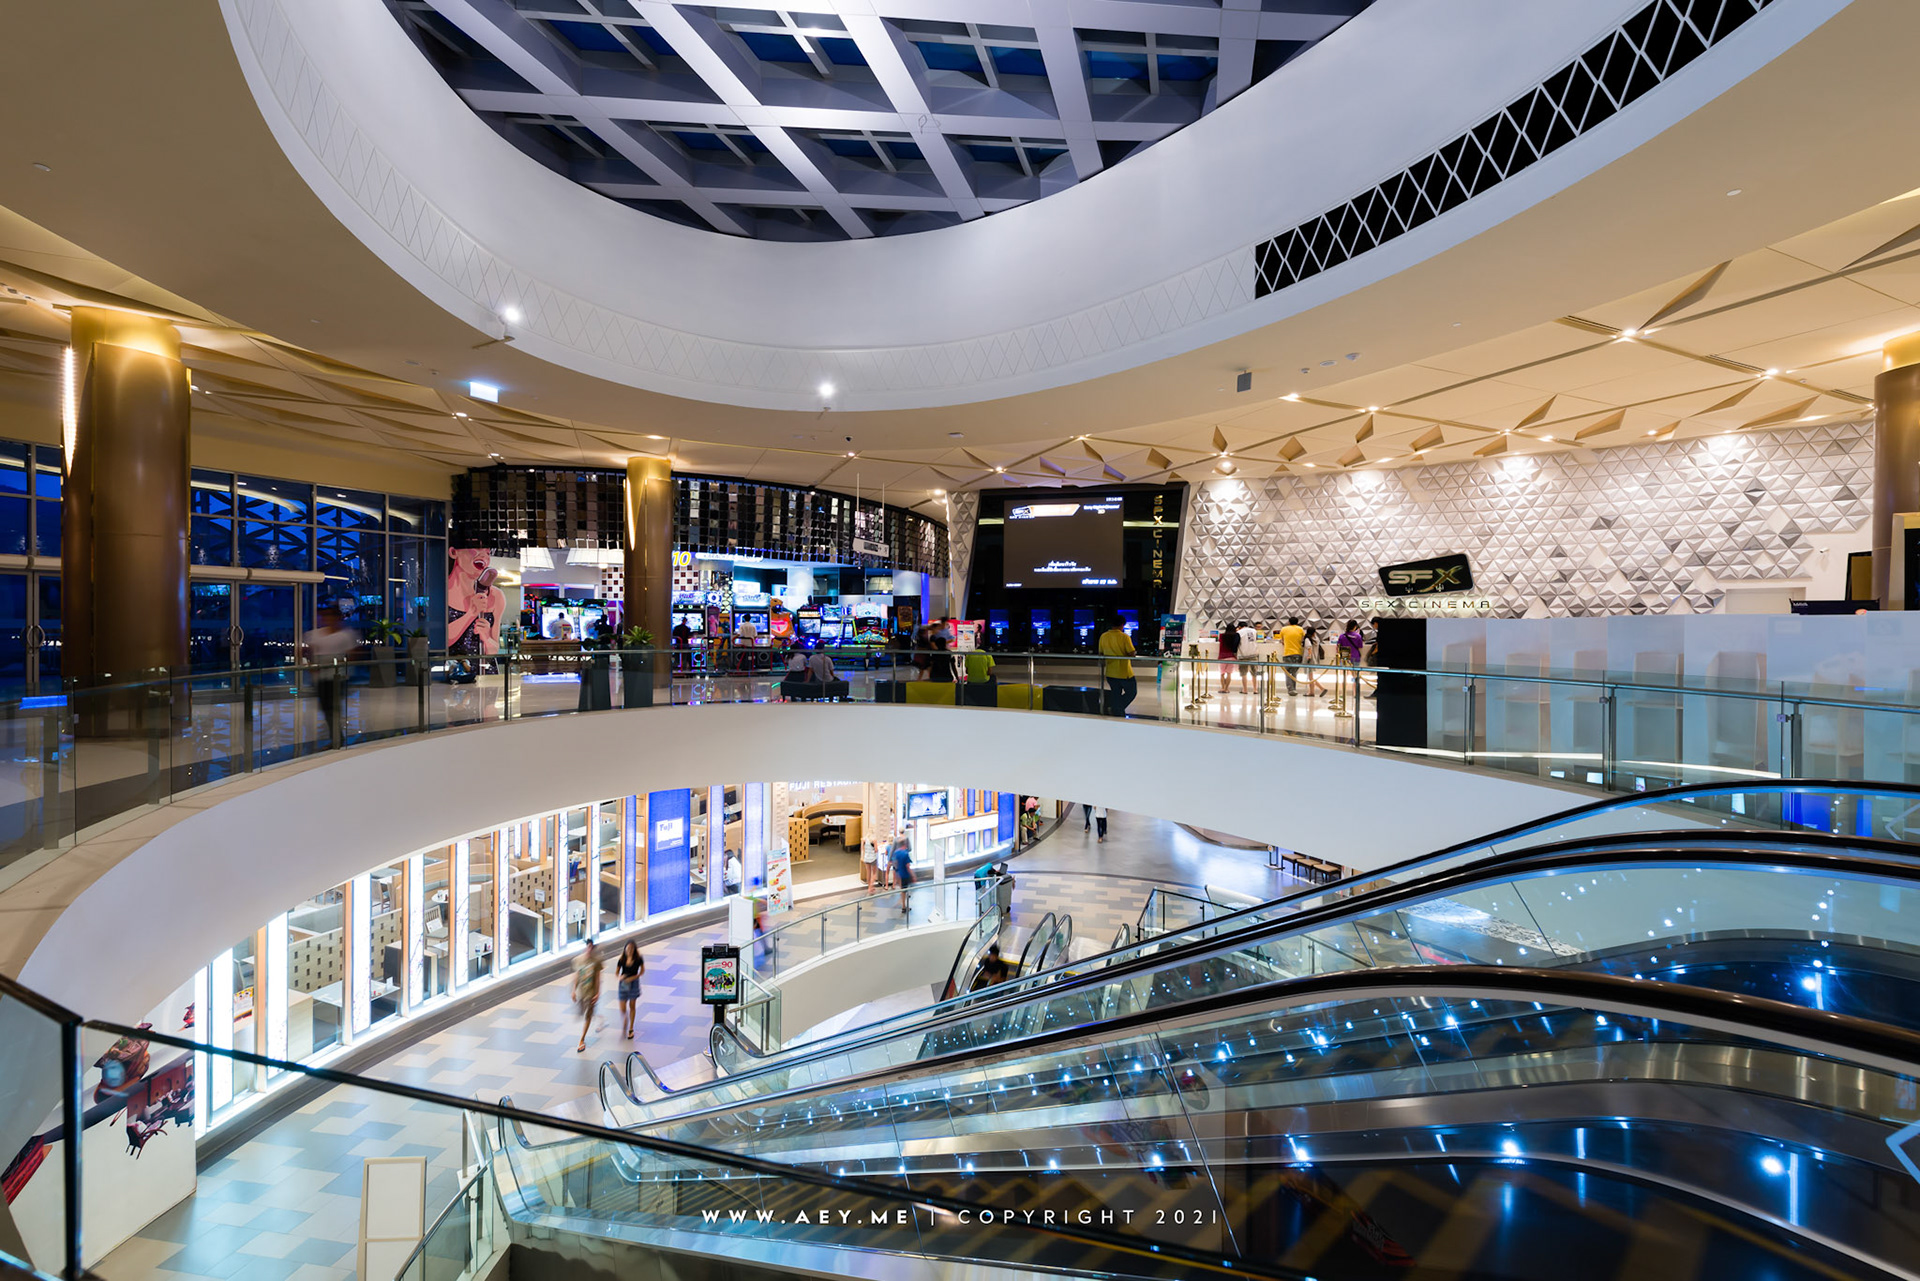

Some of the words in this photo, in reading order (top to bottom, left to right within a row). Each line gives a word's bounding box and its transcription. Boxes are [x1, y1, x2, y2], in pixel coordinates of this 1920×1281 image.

[1388, 566, 1463, 592] SFX
[1361, 600, 1396, 609] SFX
[1408, 600, 1491, 609] CINEMA
[789, 781, 810, 792] FUJI
